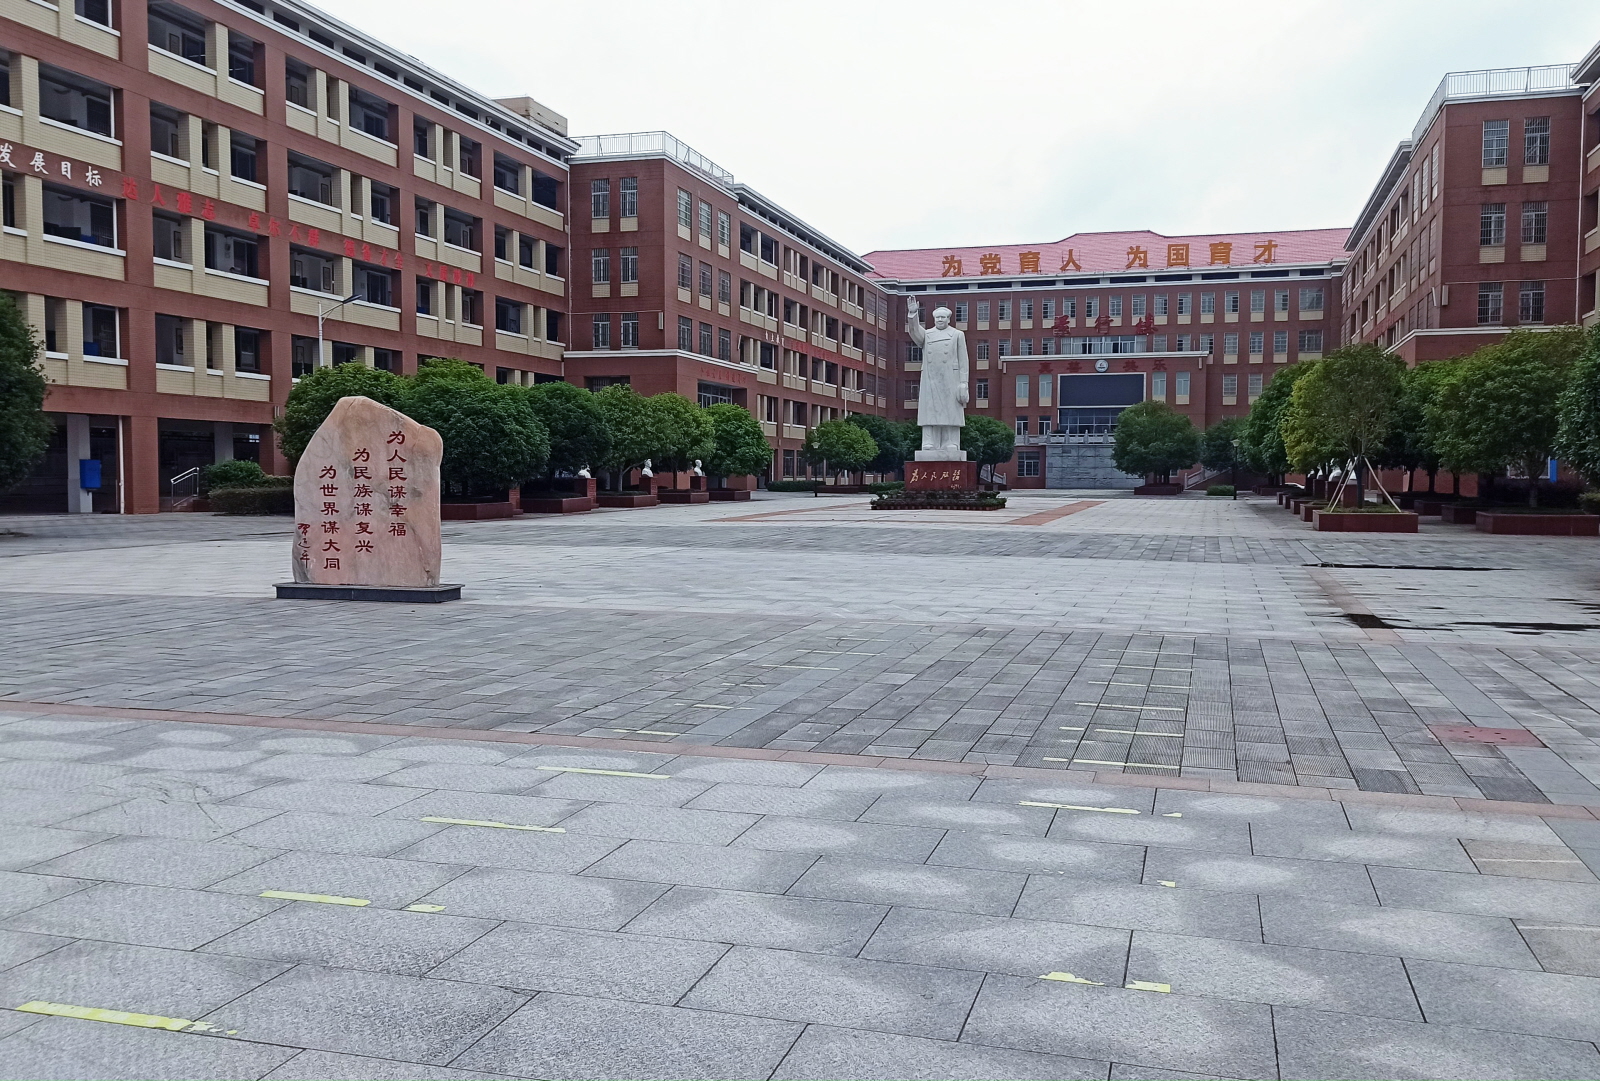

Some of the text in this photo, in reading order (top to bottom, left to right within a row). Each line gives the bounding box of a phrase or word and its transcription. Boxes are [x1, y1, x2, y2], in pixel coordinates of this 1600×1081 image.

[0, 142, 103, 187] 发展目标
[942, 240, 1278, 277] 为党育人 为国育才
[319, 465, 341, 570] 为世界谋大同
[352, 448, 374, 553] 为民族谋复兴
[386, 430, 408, 537] 为人民谋幸福
